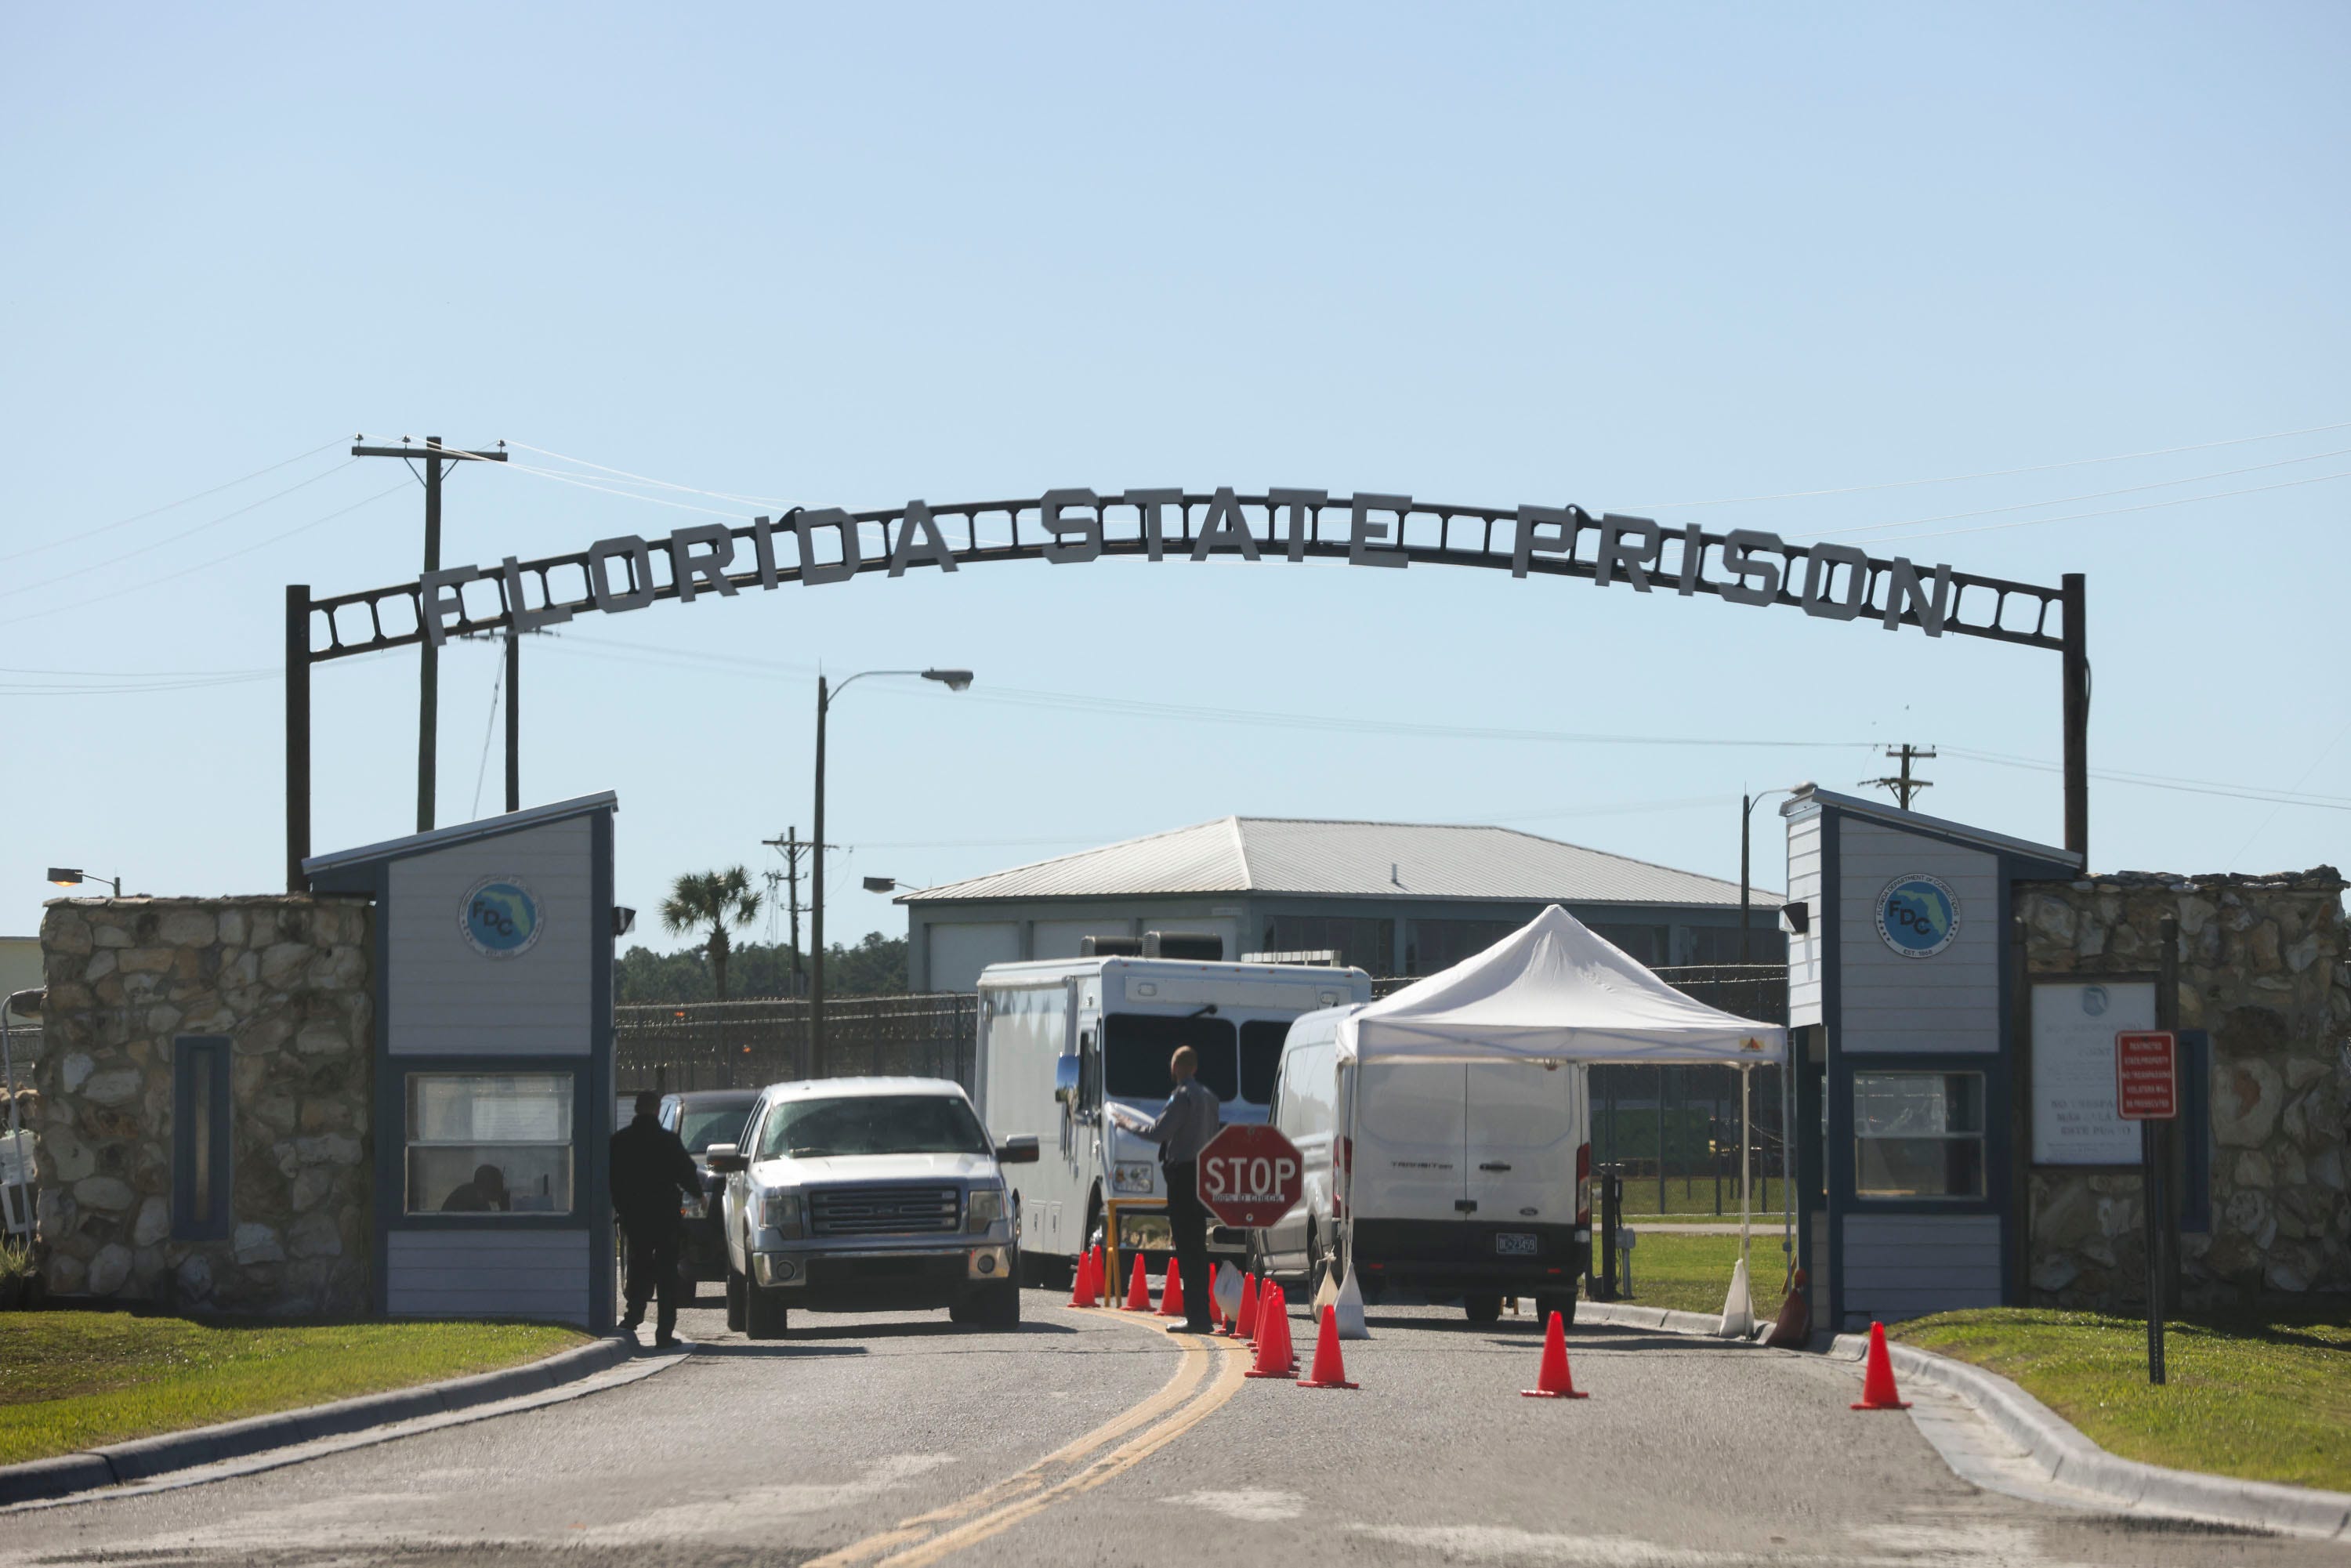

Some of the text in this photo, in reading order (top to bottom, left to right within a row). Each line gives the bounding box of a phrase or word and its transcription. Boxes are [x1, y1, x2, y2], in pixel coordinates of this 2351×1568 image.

[419, 487, 1952, 646] FLORIDA STATE PRISON
[473, 900, 514, 936] FDC
[1889, 900, 1931, 936] FDC
[1205, 1157, 1295, 1196] STOP
